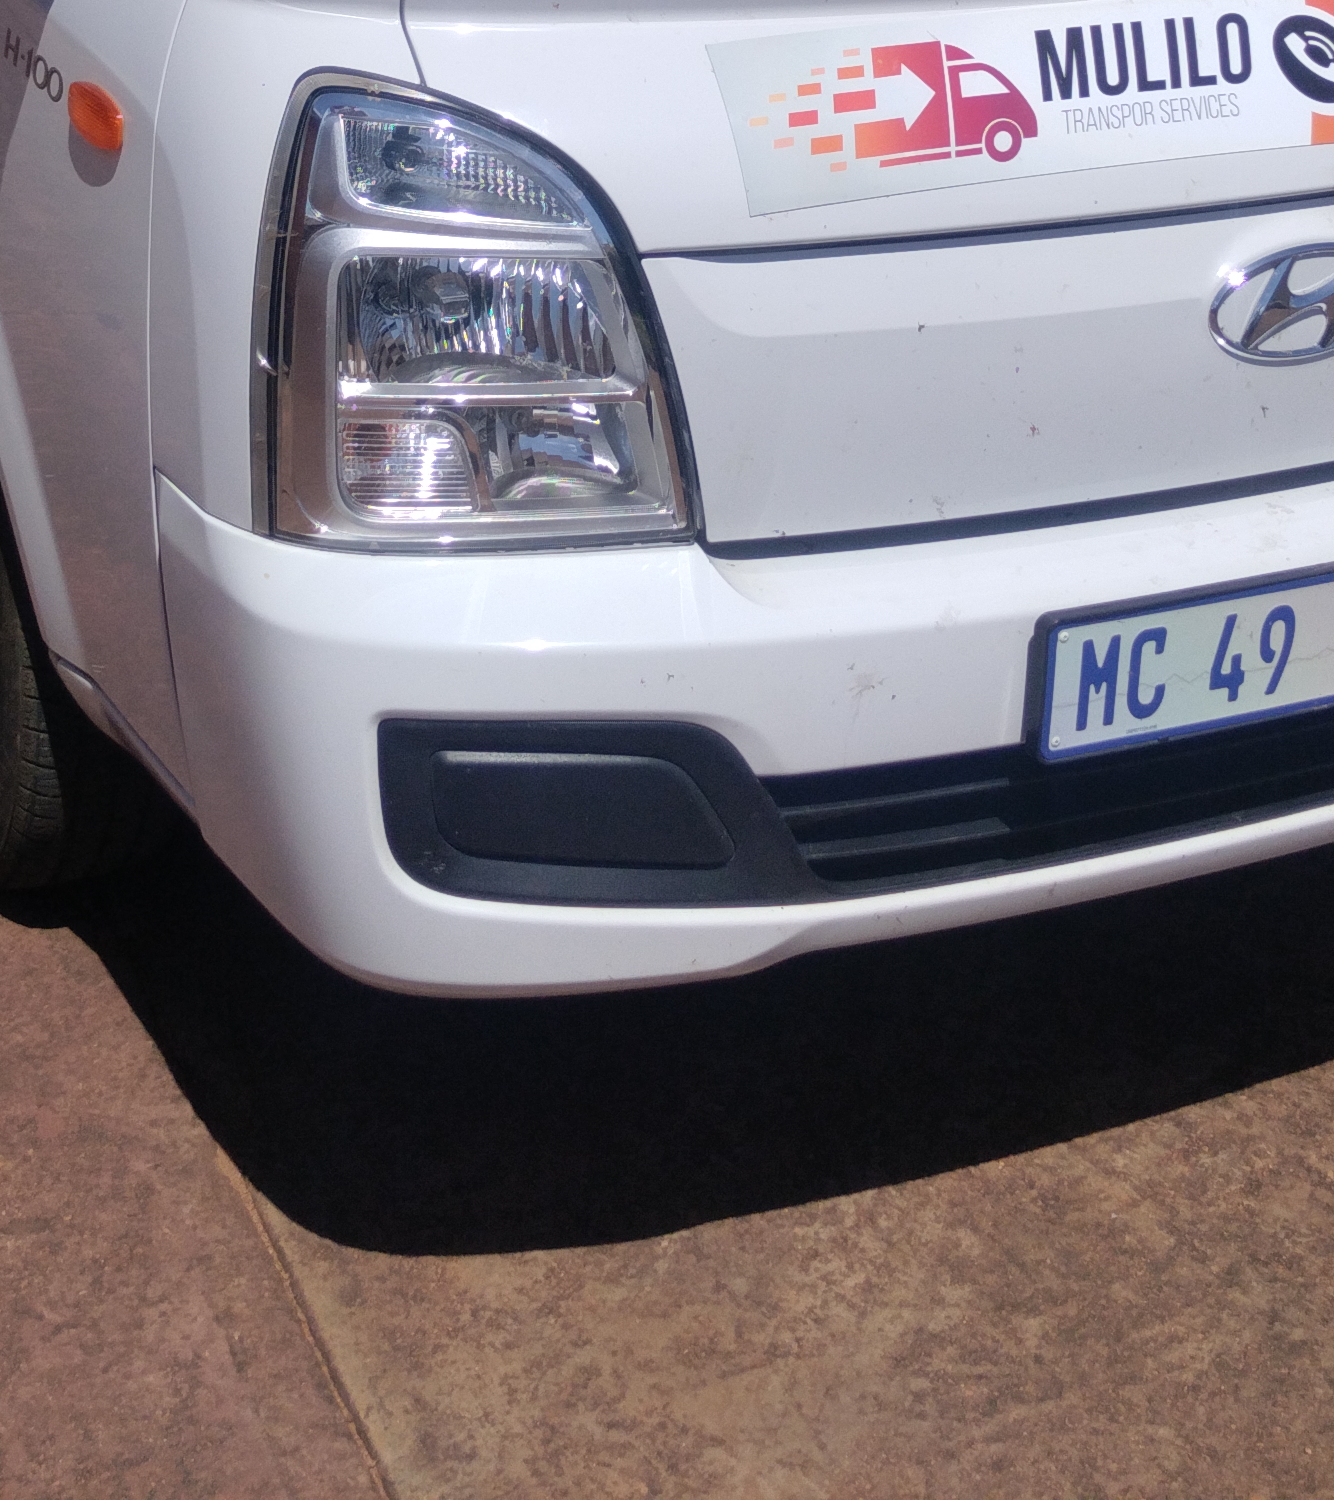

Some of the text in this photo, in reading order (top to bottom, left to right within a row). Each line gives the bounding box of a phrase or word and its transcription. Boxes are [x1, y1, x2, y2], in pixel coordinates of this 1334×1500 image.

[1034, 12, 1252, 102] MULILO
[1061, 92, 1240, 134] TRANSPOR SERVICES
[1075, 626, 1168, 732] MC
[1209, 604, 1296, 702] 49
